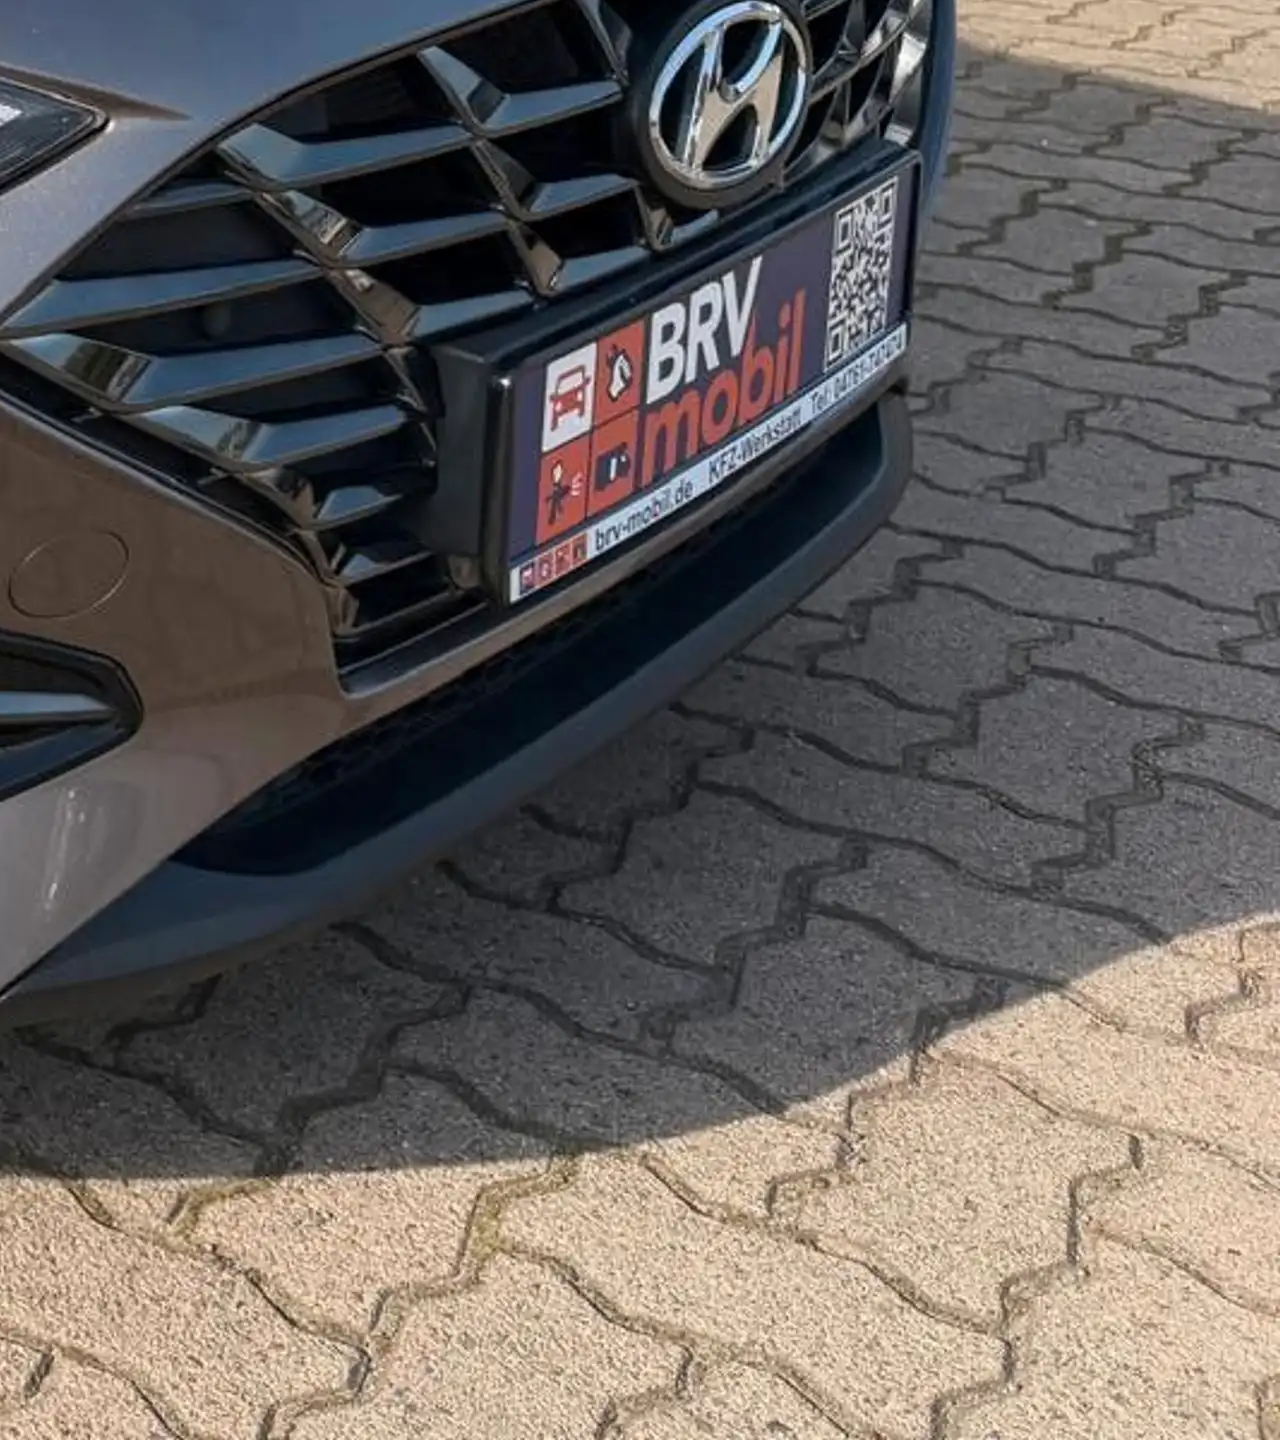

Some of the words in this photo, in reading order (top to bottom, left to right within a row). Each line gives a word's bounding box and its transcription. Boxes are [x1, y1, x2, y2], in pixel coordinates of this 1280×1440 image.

[641, 286, 807, 488] mobil
[646, 254, 764, 405] BRV
[594, 479, 694, 552] brv-mobil.de
